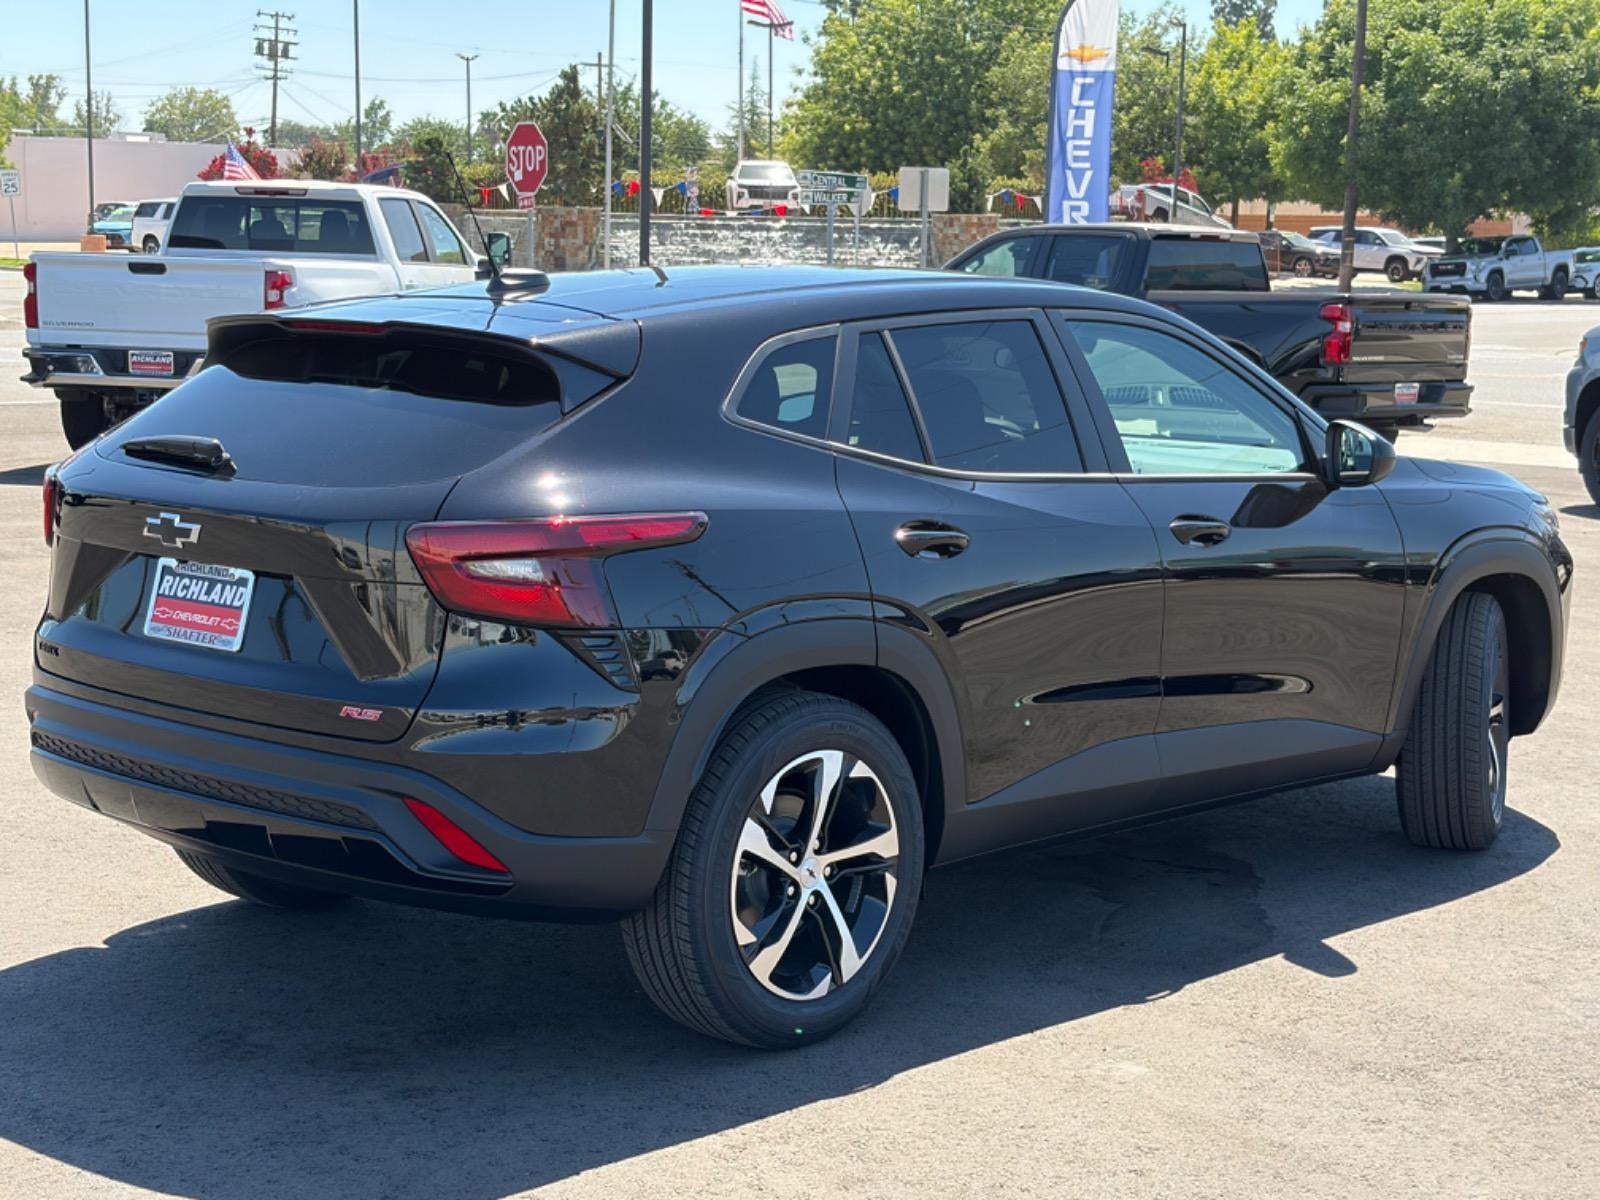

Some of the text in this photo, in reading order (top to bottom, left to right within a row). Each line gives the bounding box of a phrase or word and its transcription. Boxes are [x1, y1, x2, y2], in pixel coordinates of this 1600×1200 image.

[508, 145, 545, 172] STOP
[4, 183, 18, 193] 25
[811, 173, 847, 187] CENTRAL
[813, 191, 848, 204] WALKER
[130, 355, 172, 363] RICHLAND
[159, 575, 247, 607] RICHLAND
[172, 610, 221, 626] CHEVROLET
[167, 626, 217, 645] SHAFTER
[339, 705, 383, 721] RS
